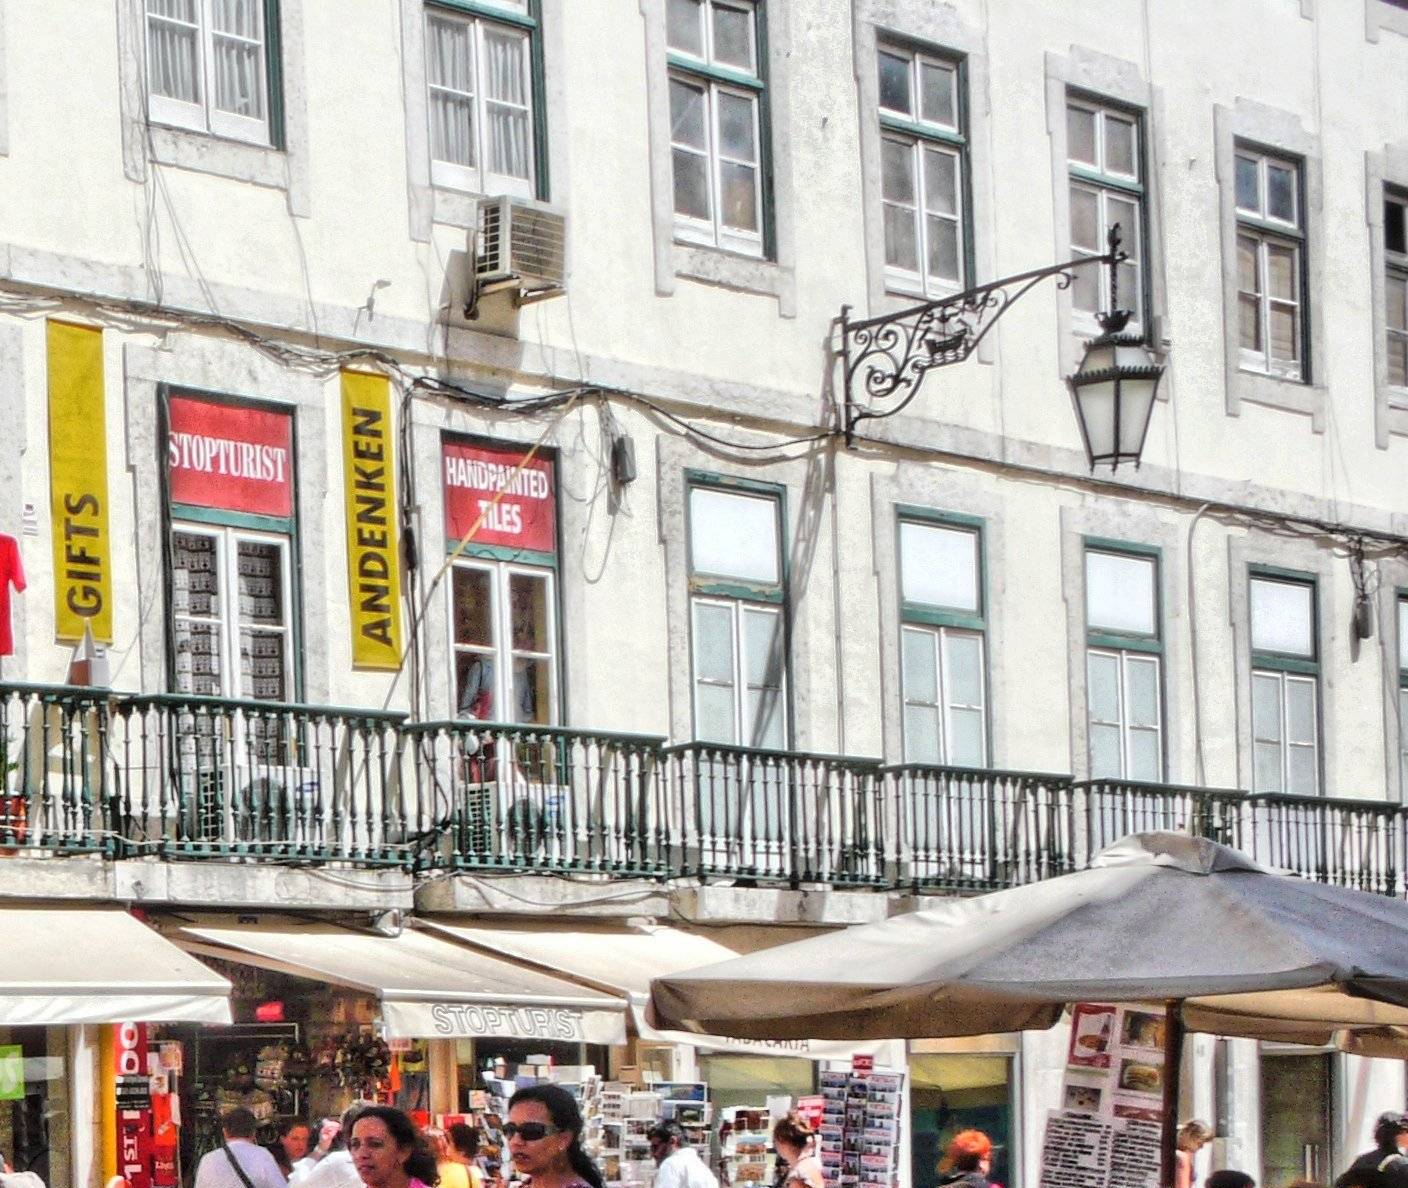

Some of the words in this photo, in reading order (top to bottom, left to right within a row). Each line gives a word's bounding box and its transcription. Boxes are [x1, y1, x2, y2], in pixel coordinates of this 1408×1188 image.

[168, 431, 288, 485] STOPTURIST
[445, 455, 549, 501] HANDPAINTED
[350, 404, 395, 648] ANDENKEN
[477, 499, 523, 536] TILES
[64, 492, 103, 618] GIFTS
[430, 1003, 585, 1041] STOPTURIST
